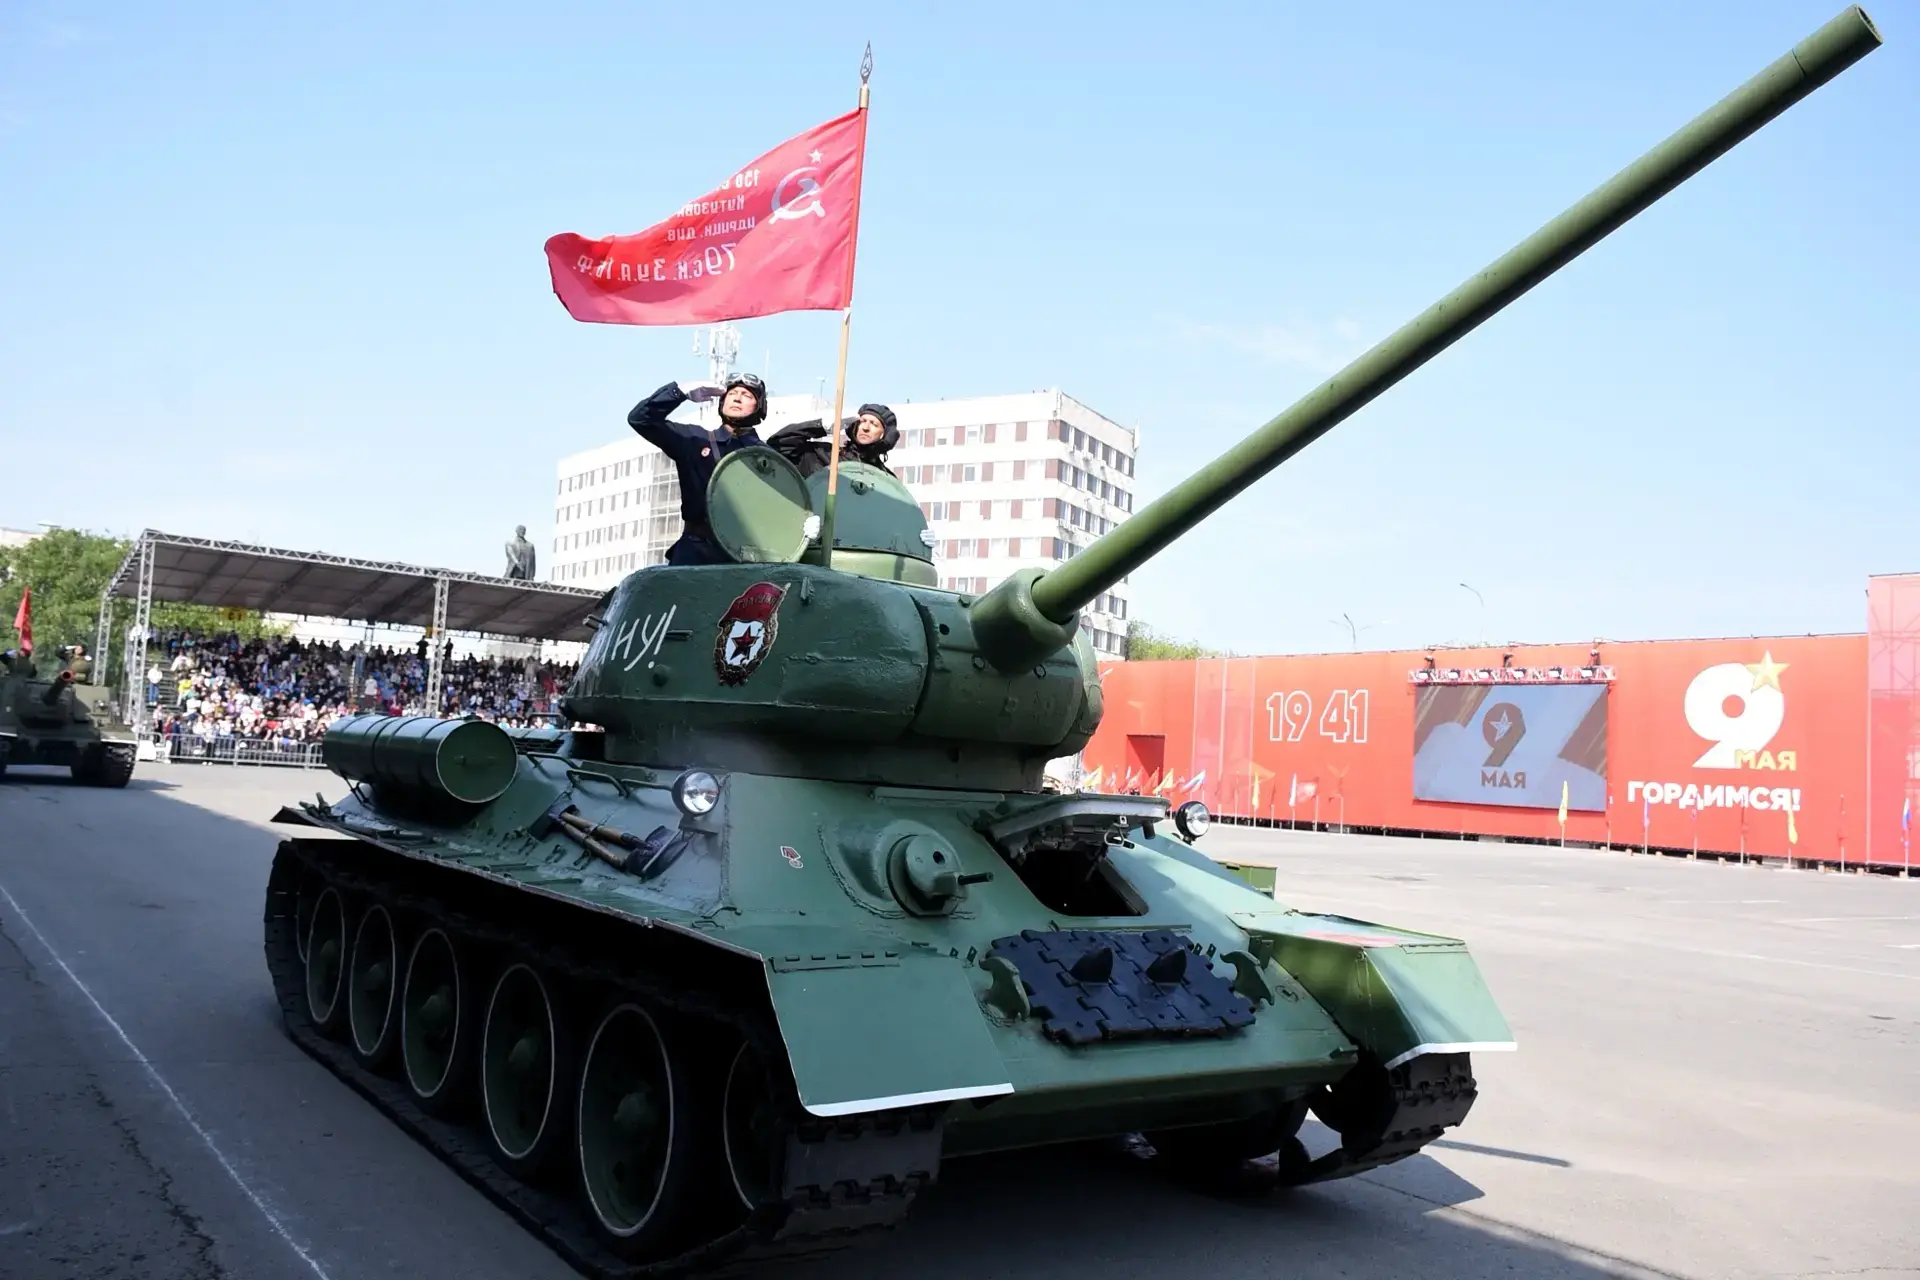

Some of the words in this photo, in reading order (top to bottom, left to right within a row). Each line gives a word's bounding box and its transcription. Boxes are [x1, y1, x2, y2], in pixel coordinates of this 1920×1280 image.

[1684, 663, 1784, 769] 9
[1482, 702, 1527, 767] 9
[1734, 749, 1797, 771] МАЯ
[1481, 770, 1527, 789] МАЯ
[1627, 780, 1802, 812] ГОРДИМСЯ!
